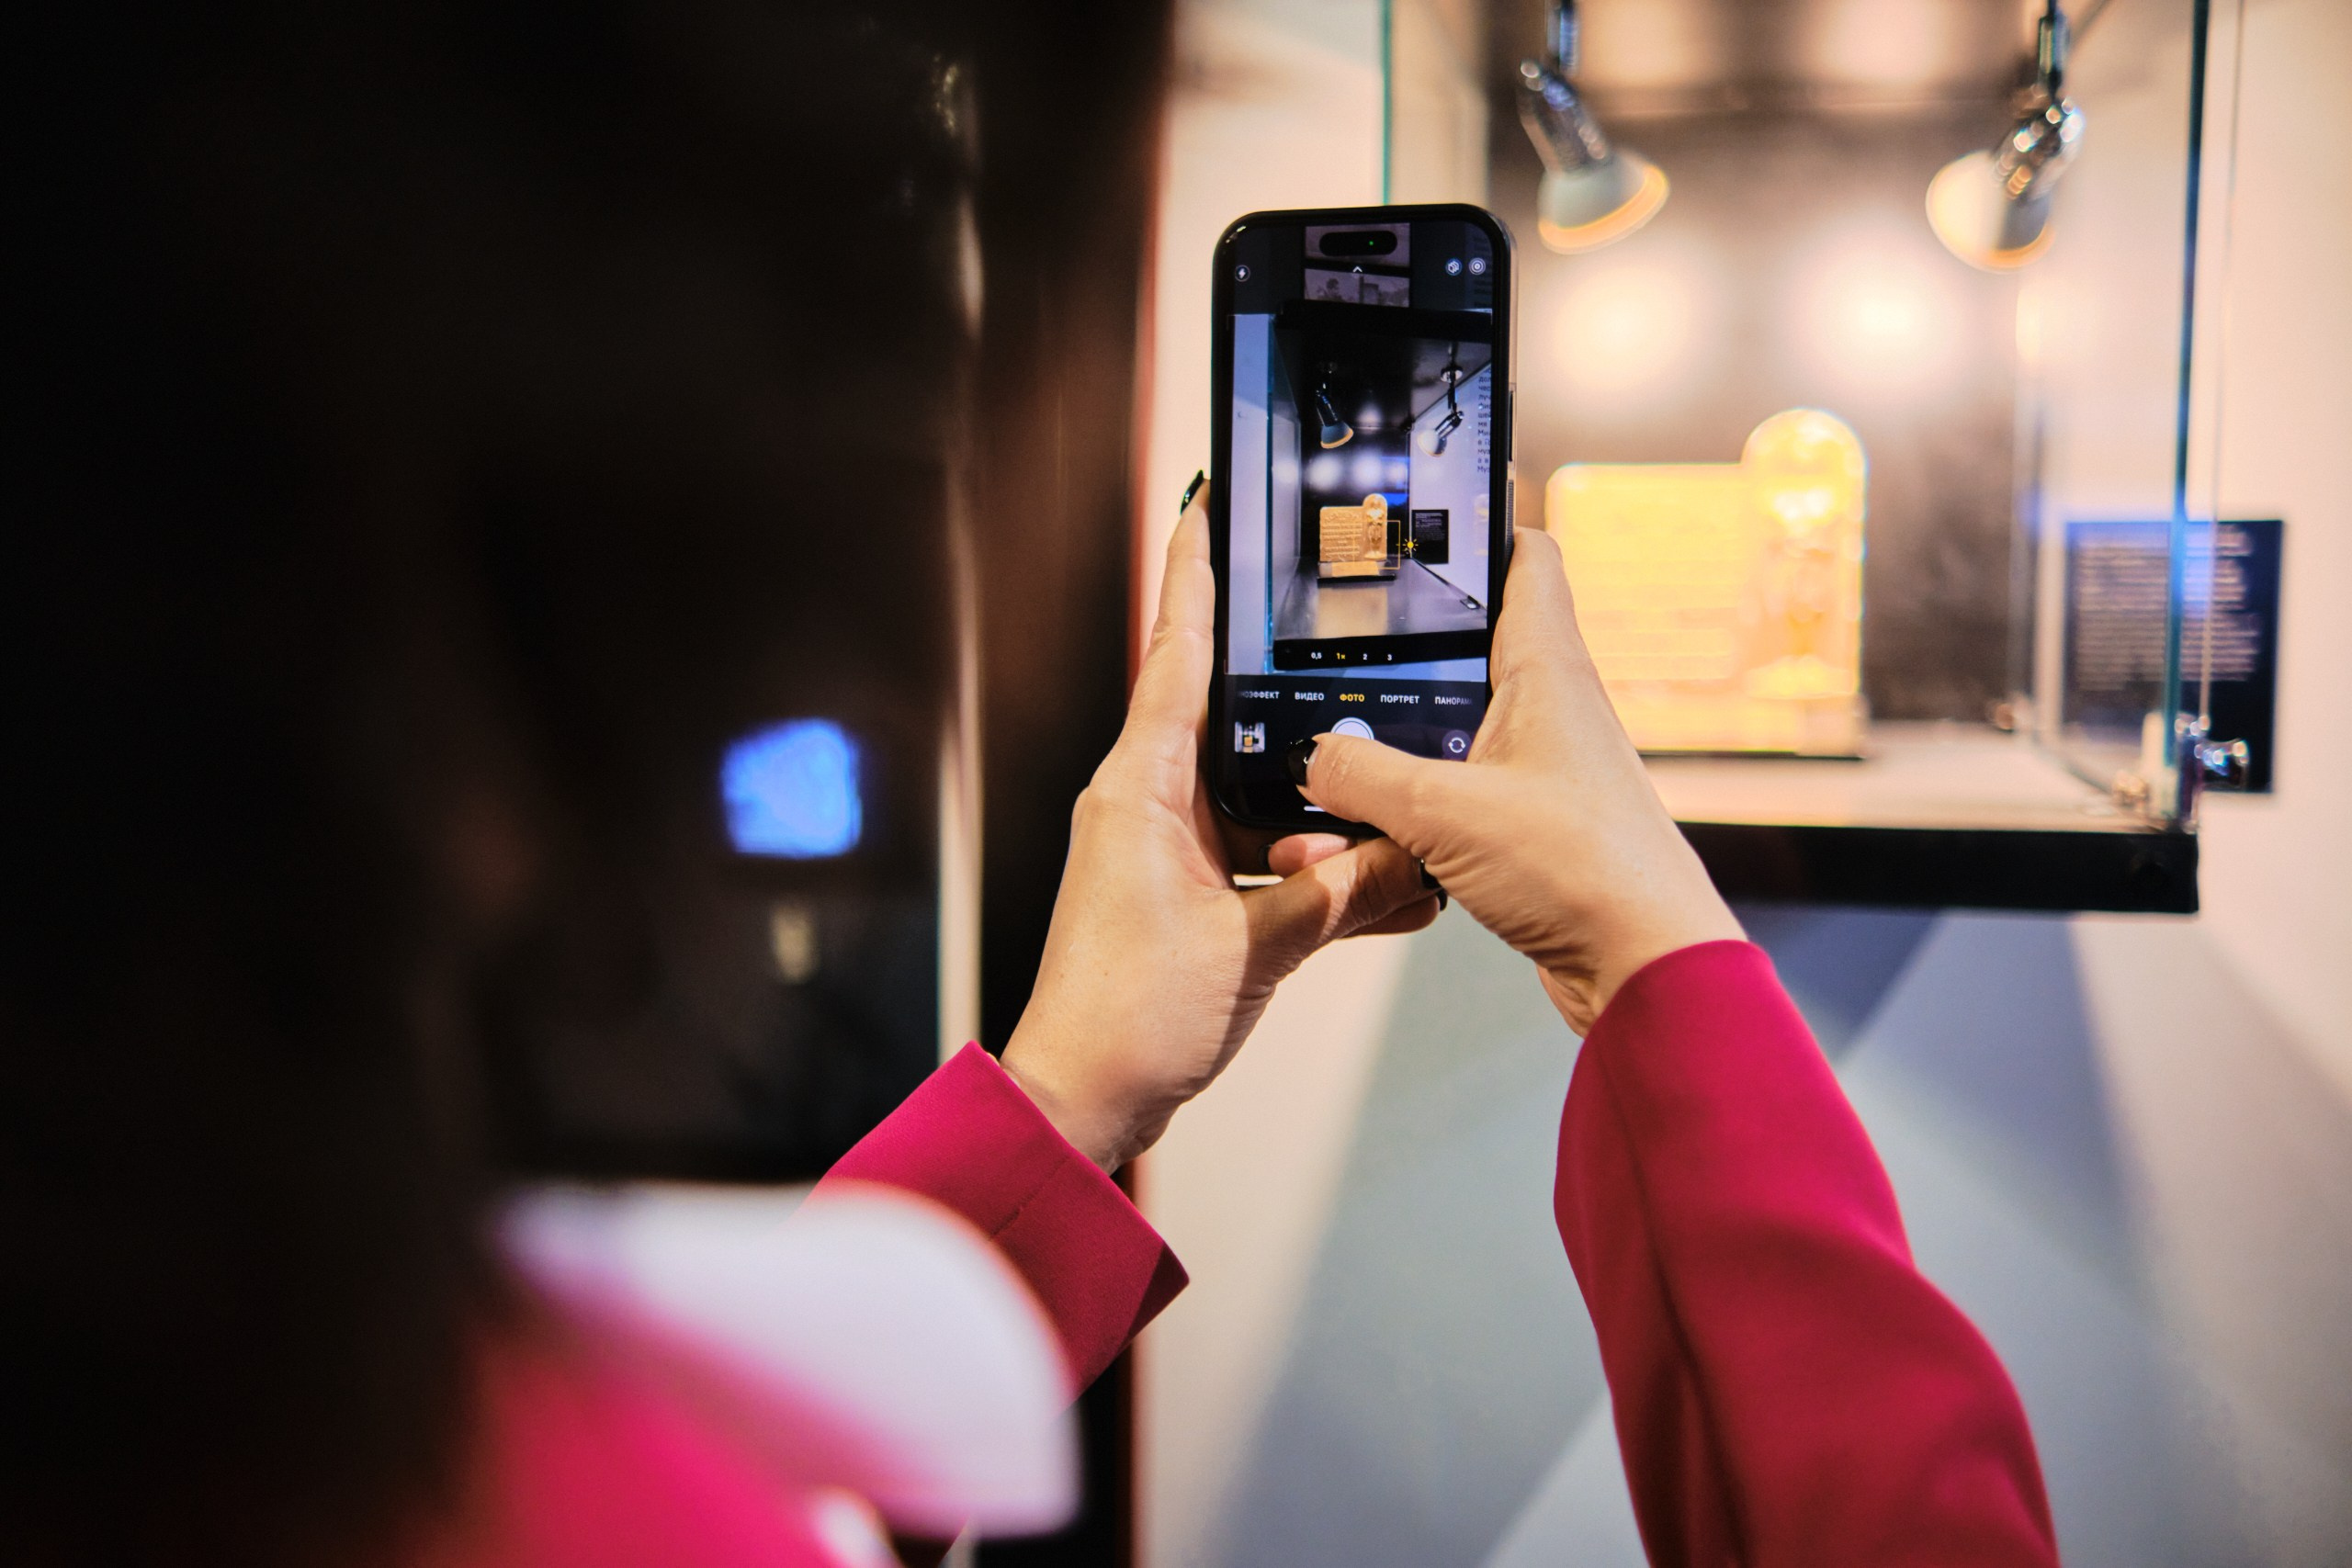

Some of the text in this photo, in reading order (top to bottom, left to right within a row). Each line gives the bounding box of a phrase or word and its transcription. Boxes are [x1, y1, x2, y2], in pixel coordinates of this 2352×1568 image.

[1295, 692, 1325, 701] ВИДЕО
[1340, 694, 1365, 703] ФОТО
[1380, 694, 1420, 705] ПОРТРЕТ
